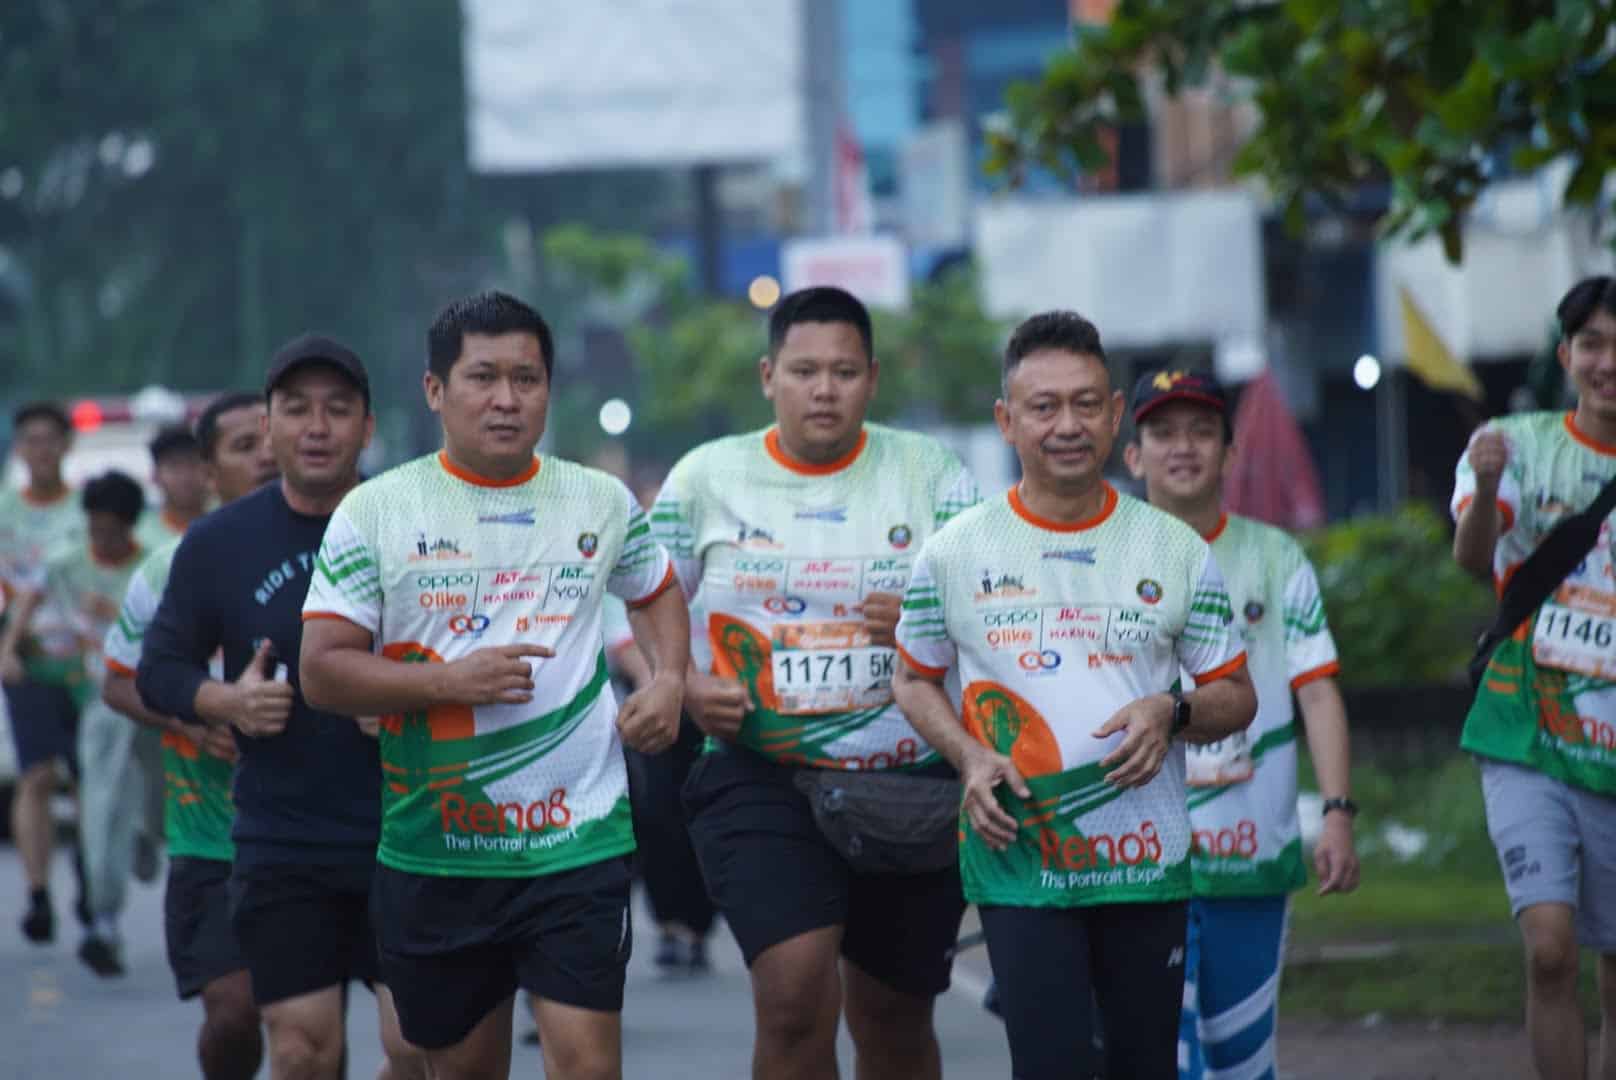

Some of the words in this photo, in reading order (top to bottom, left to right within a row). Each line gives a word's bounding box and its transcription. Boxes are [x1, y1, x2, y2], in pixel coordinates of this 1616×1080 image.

[255, 559, 295, 606] RIDE
[553, 584, 590, 600] YOU
[1545, 612, 1612, 648] 1146
[779, 655, 853, 683] 1171
[870, 652, 895, 677] 5K
[440, 788, 571, 833] Reno8
[445, 833, 471, 850] The
[474, 835, 527, 852] Portrait
[529, 828, 578, 850] Expert
[1038, 820, 1162, 870] Reno8
[1040, 870, 1066, 889] The
[1069, 869, 1123, 888] Portrait
